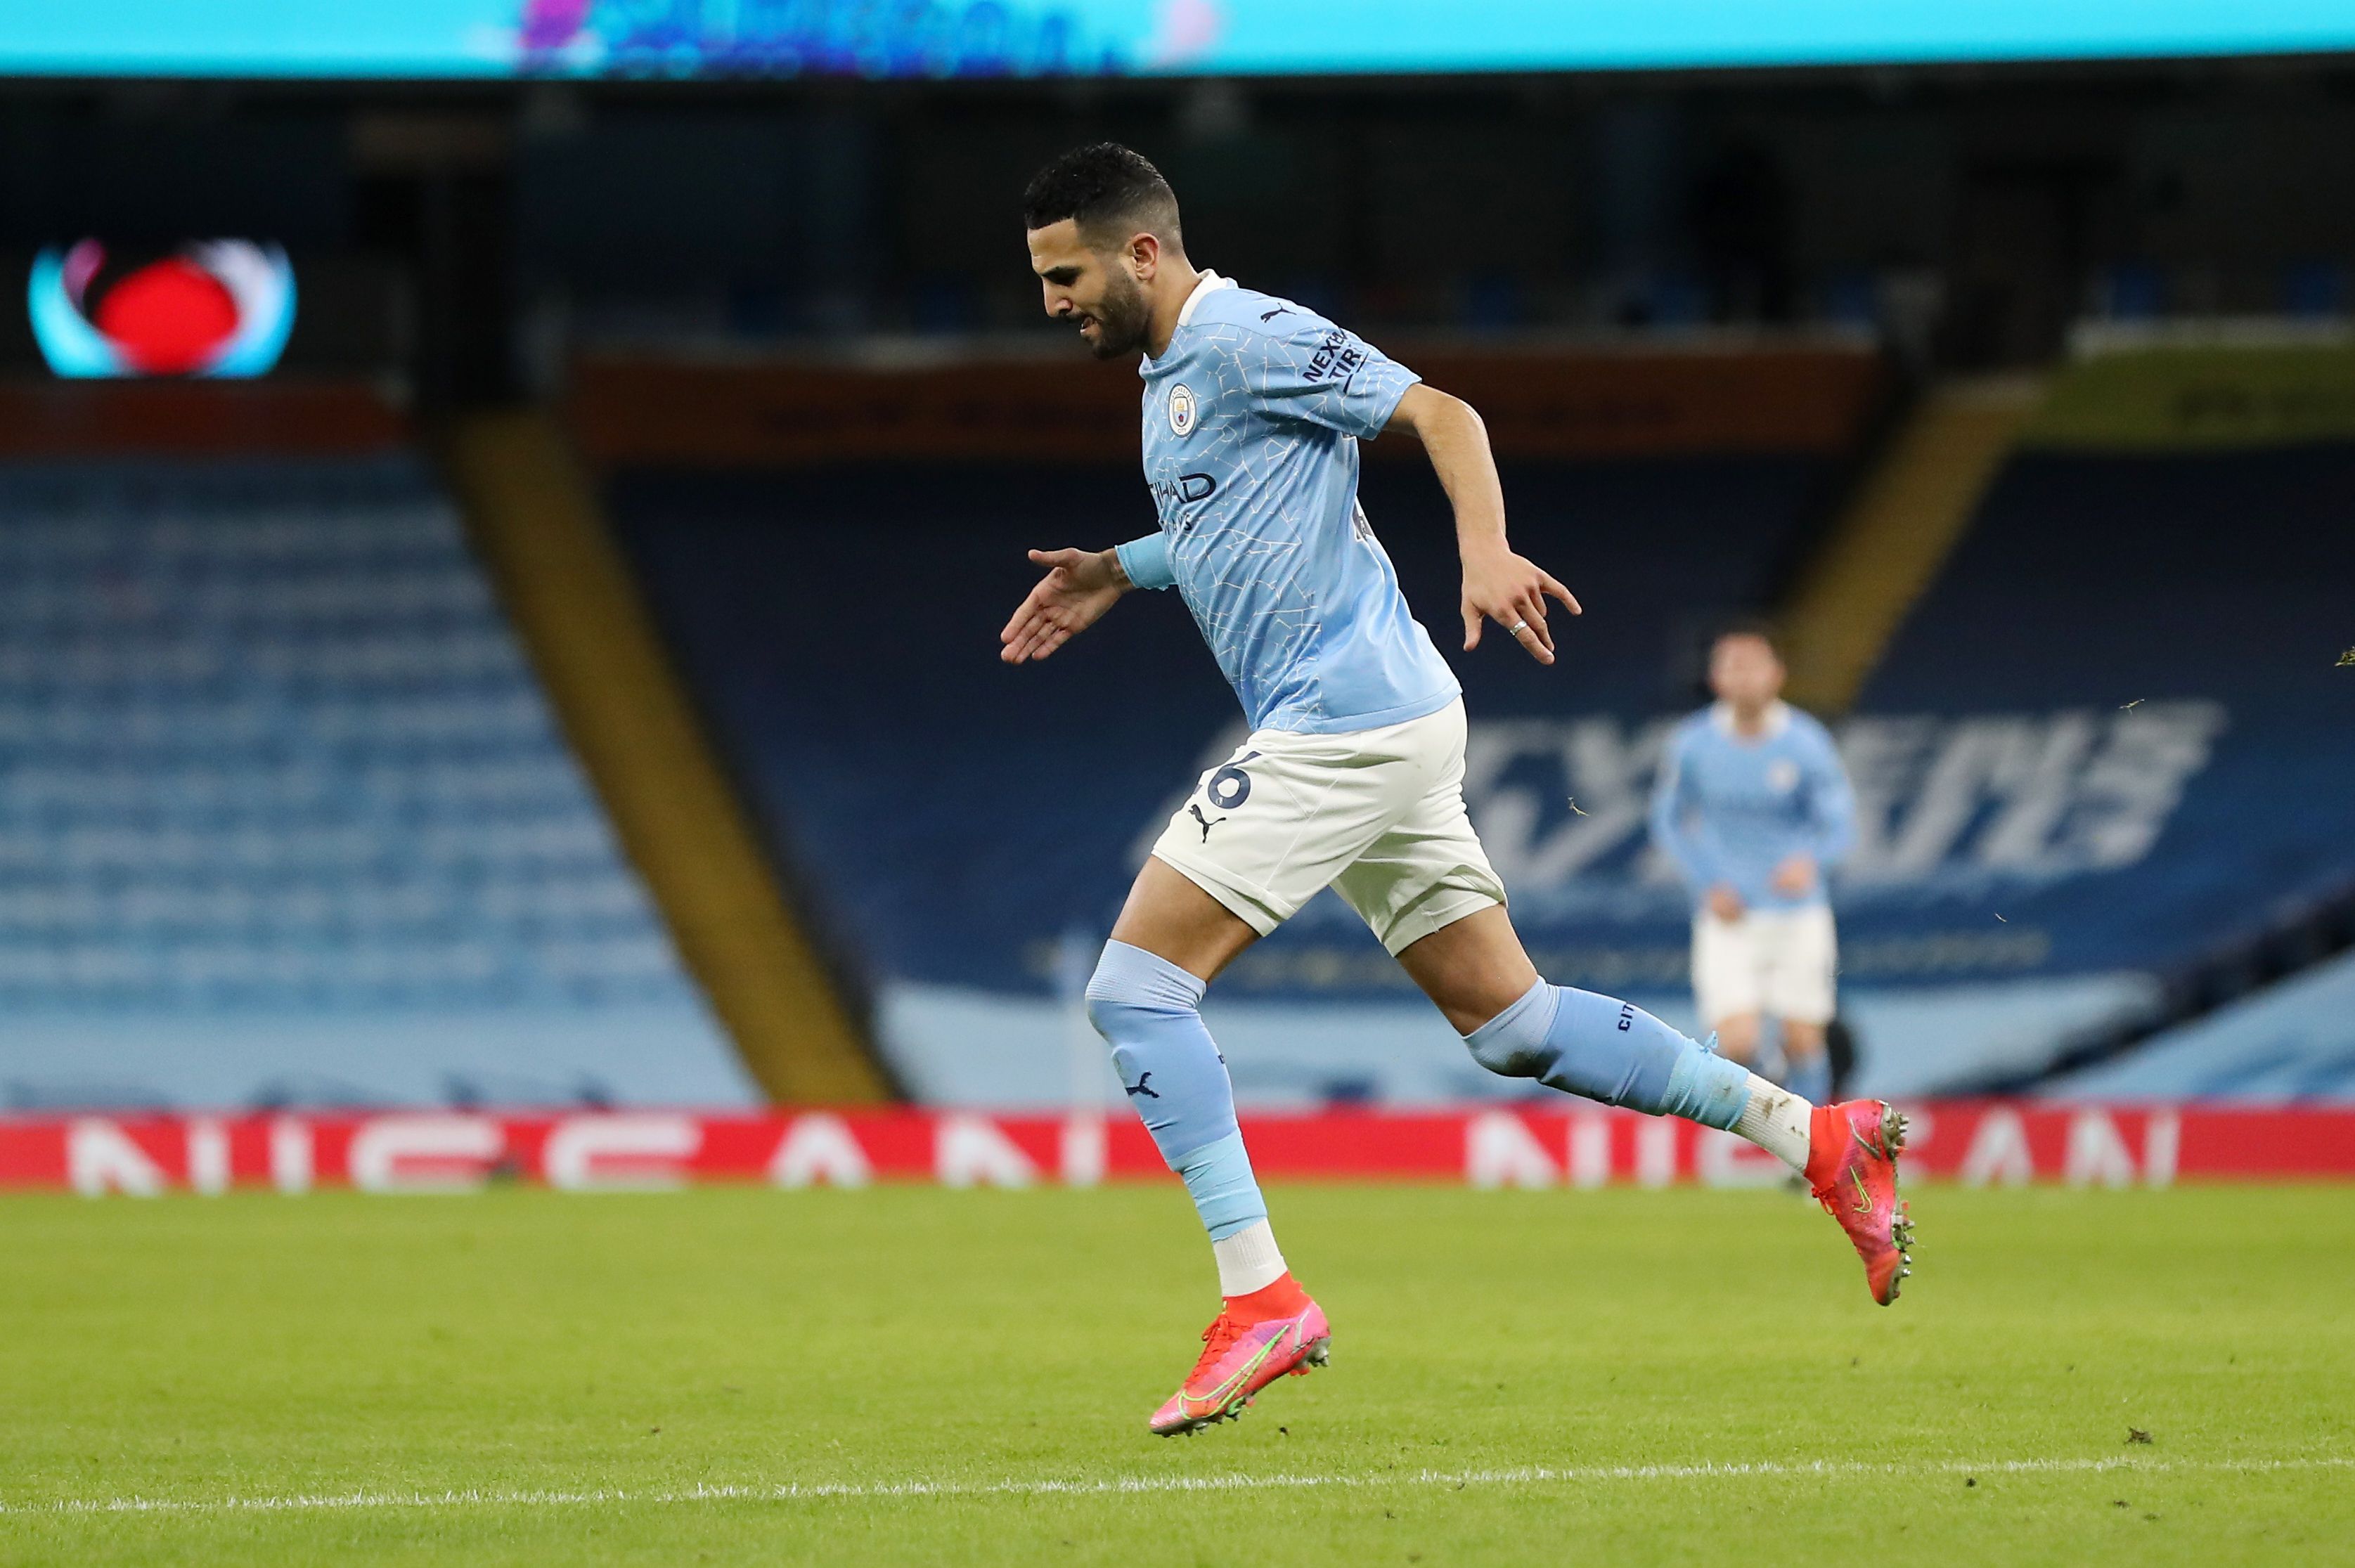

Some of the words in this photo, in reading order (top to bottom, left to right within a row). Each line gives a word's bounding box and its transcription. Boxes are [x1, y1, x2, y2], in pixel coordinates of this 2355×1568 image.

[1327, 344, 1362, 379] TIR
[1193, 751, 1263, 809] 6
[1618, 1002, 1635, 1032] CIT
